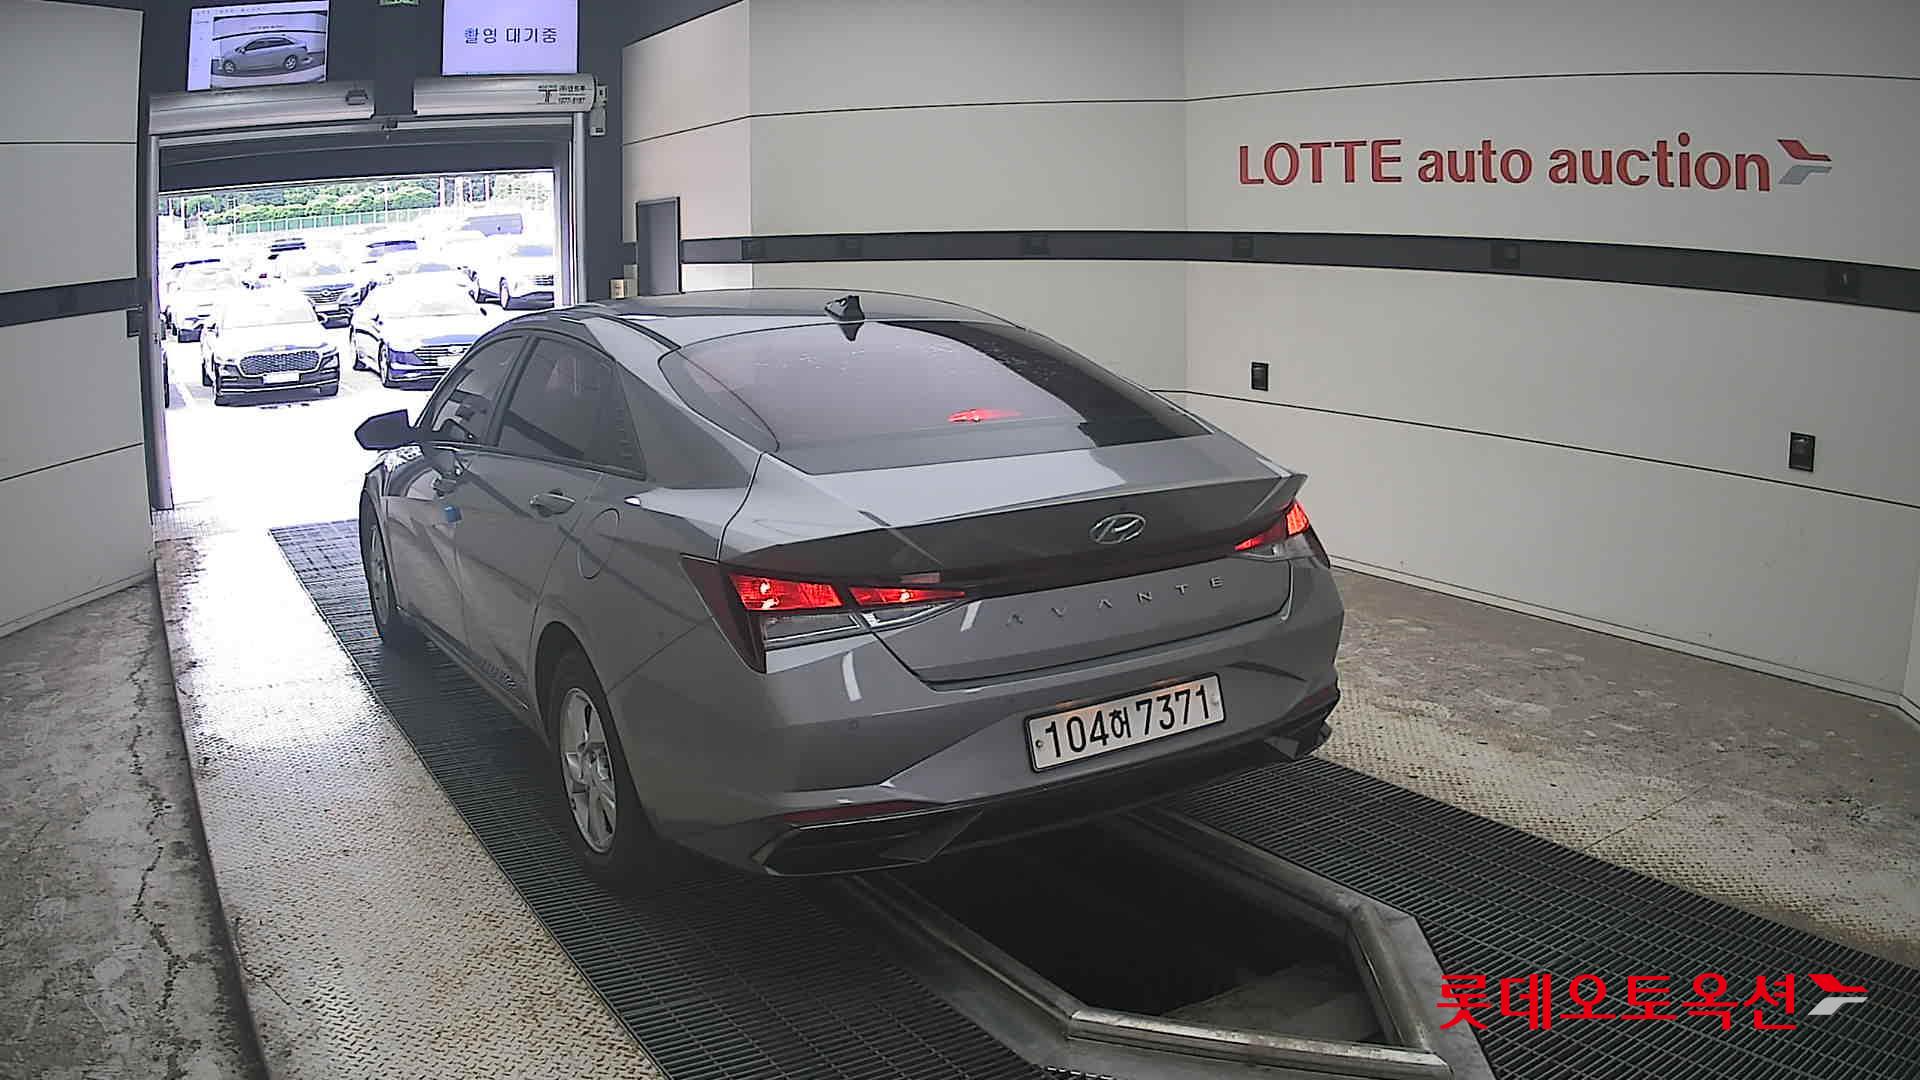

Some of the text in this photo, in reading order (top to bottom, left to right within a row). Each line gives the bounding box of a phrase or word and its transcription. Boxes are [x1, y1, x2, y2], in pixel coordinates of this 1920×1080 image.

[506, 27, 557, 44] 대기중
[1238, 132, 1771, 192] LOTTE auto auction
[1007, 576, 1225, 625] AVANTE
